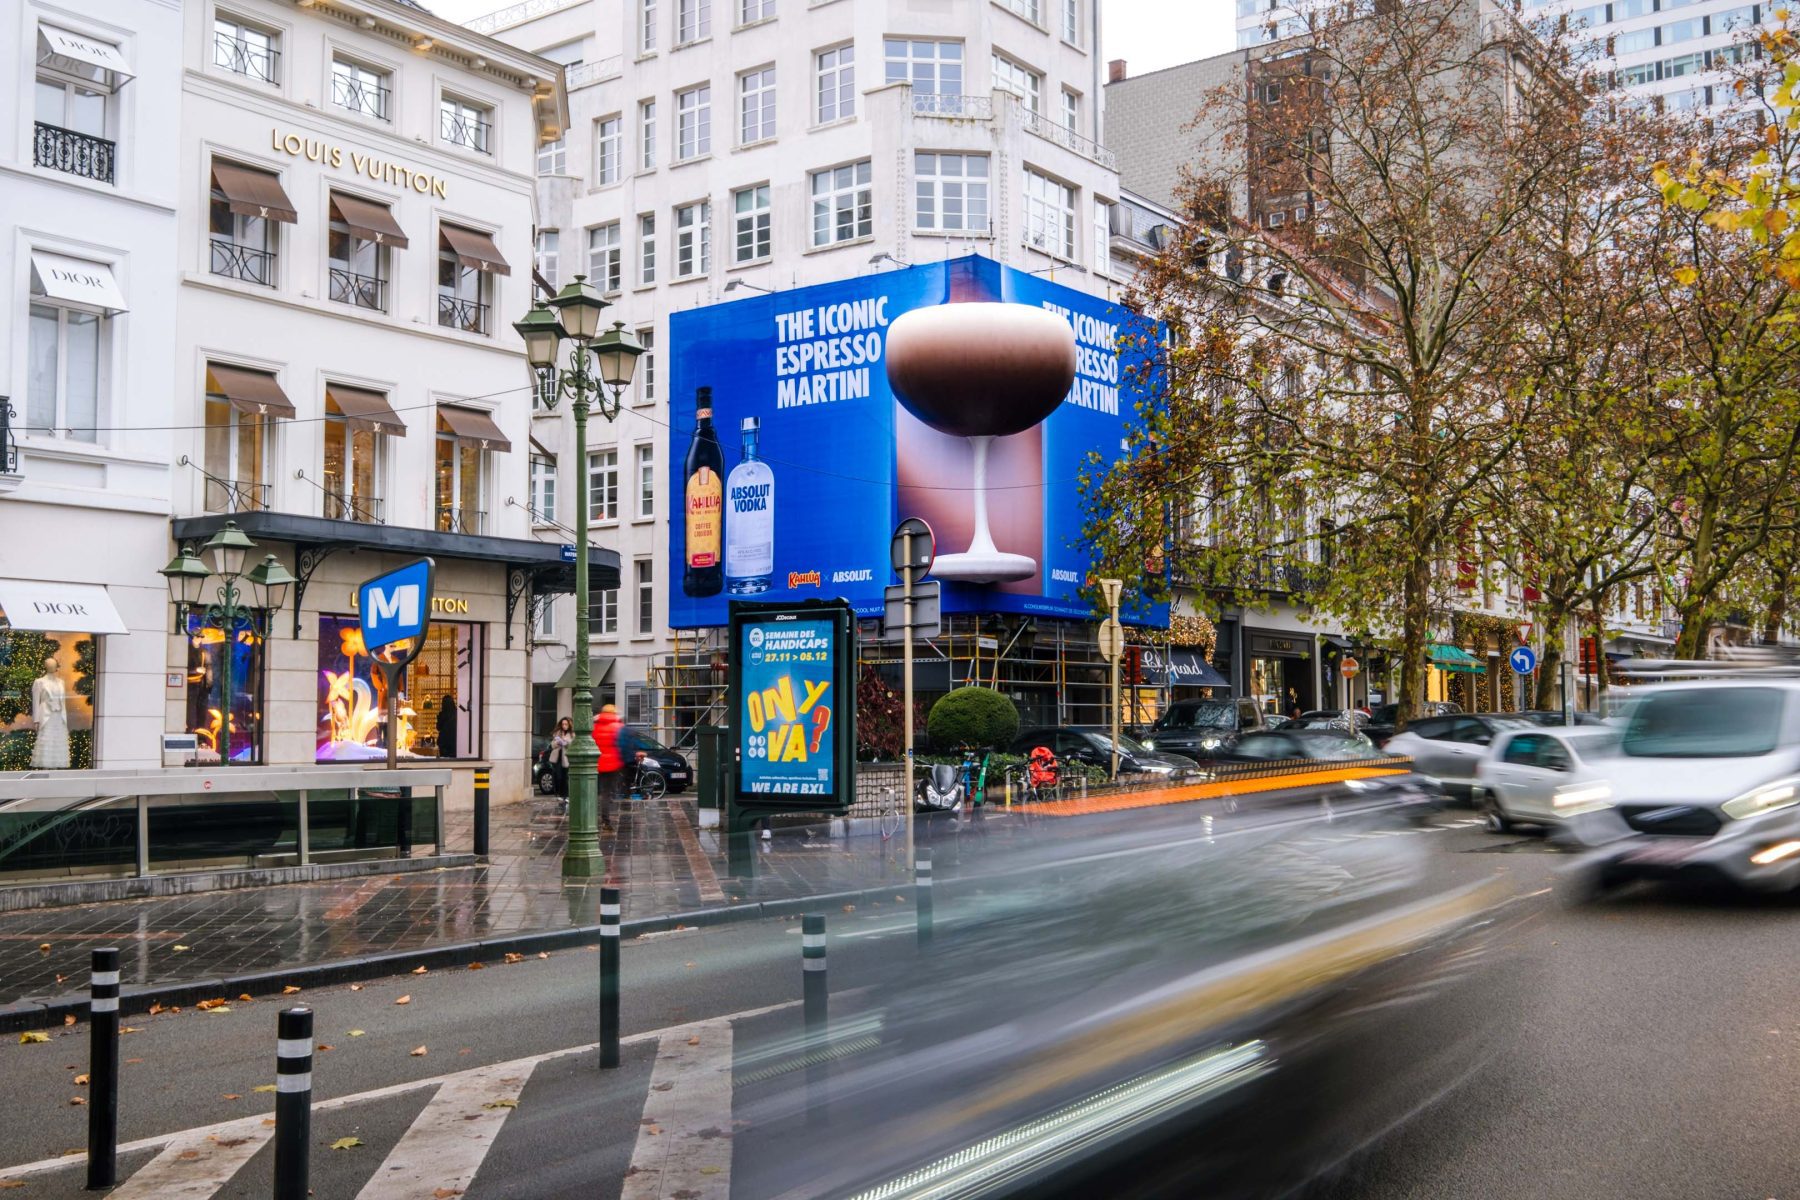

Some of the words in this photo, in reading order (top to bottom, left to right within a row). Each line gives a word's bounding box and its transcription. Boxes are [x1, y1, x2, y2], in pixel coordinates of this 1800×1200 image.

[59, 36, 112, 61] DIOR
[273, 128, 343, 169] LOUIS
[351, 152, 446, 200] VUITTON
[51, 268, 105, 289] DIOR
[775, 308, 815, 344] THE
[818, 295, 889, 337] ICONIC
[1072, 311, 1119, 353] ICONIC
[776, 331, 881, 377] ESPRESSO
[1075, 344, 1119, 385] RESSO
[777, 367, 870, 410] MARTINI
[731, 484, 771, 500] ABSOLUT
[734, 498, 767, 513] VODKA
[33, 601, 89, 616] DIOR
[367, 584, 420, 629] M
[431, 597, 468, 613] TTON
[765, 631, 799, 640] SEMAINE
[799, 630, 816, 639] DES
[765, 638, 829, 651] HANDICAPS
[764, 652, 790, 662] 27.11
[799, 651, 828, 662] 05.12
[1143, 650, 1203, 679] Chpard
[751, 782, 771, 793] WE
[772, 782, 799, 794] ARE
[800, 783, 826, 795] BXL
